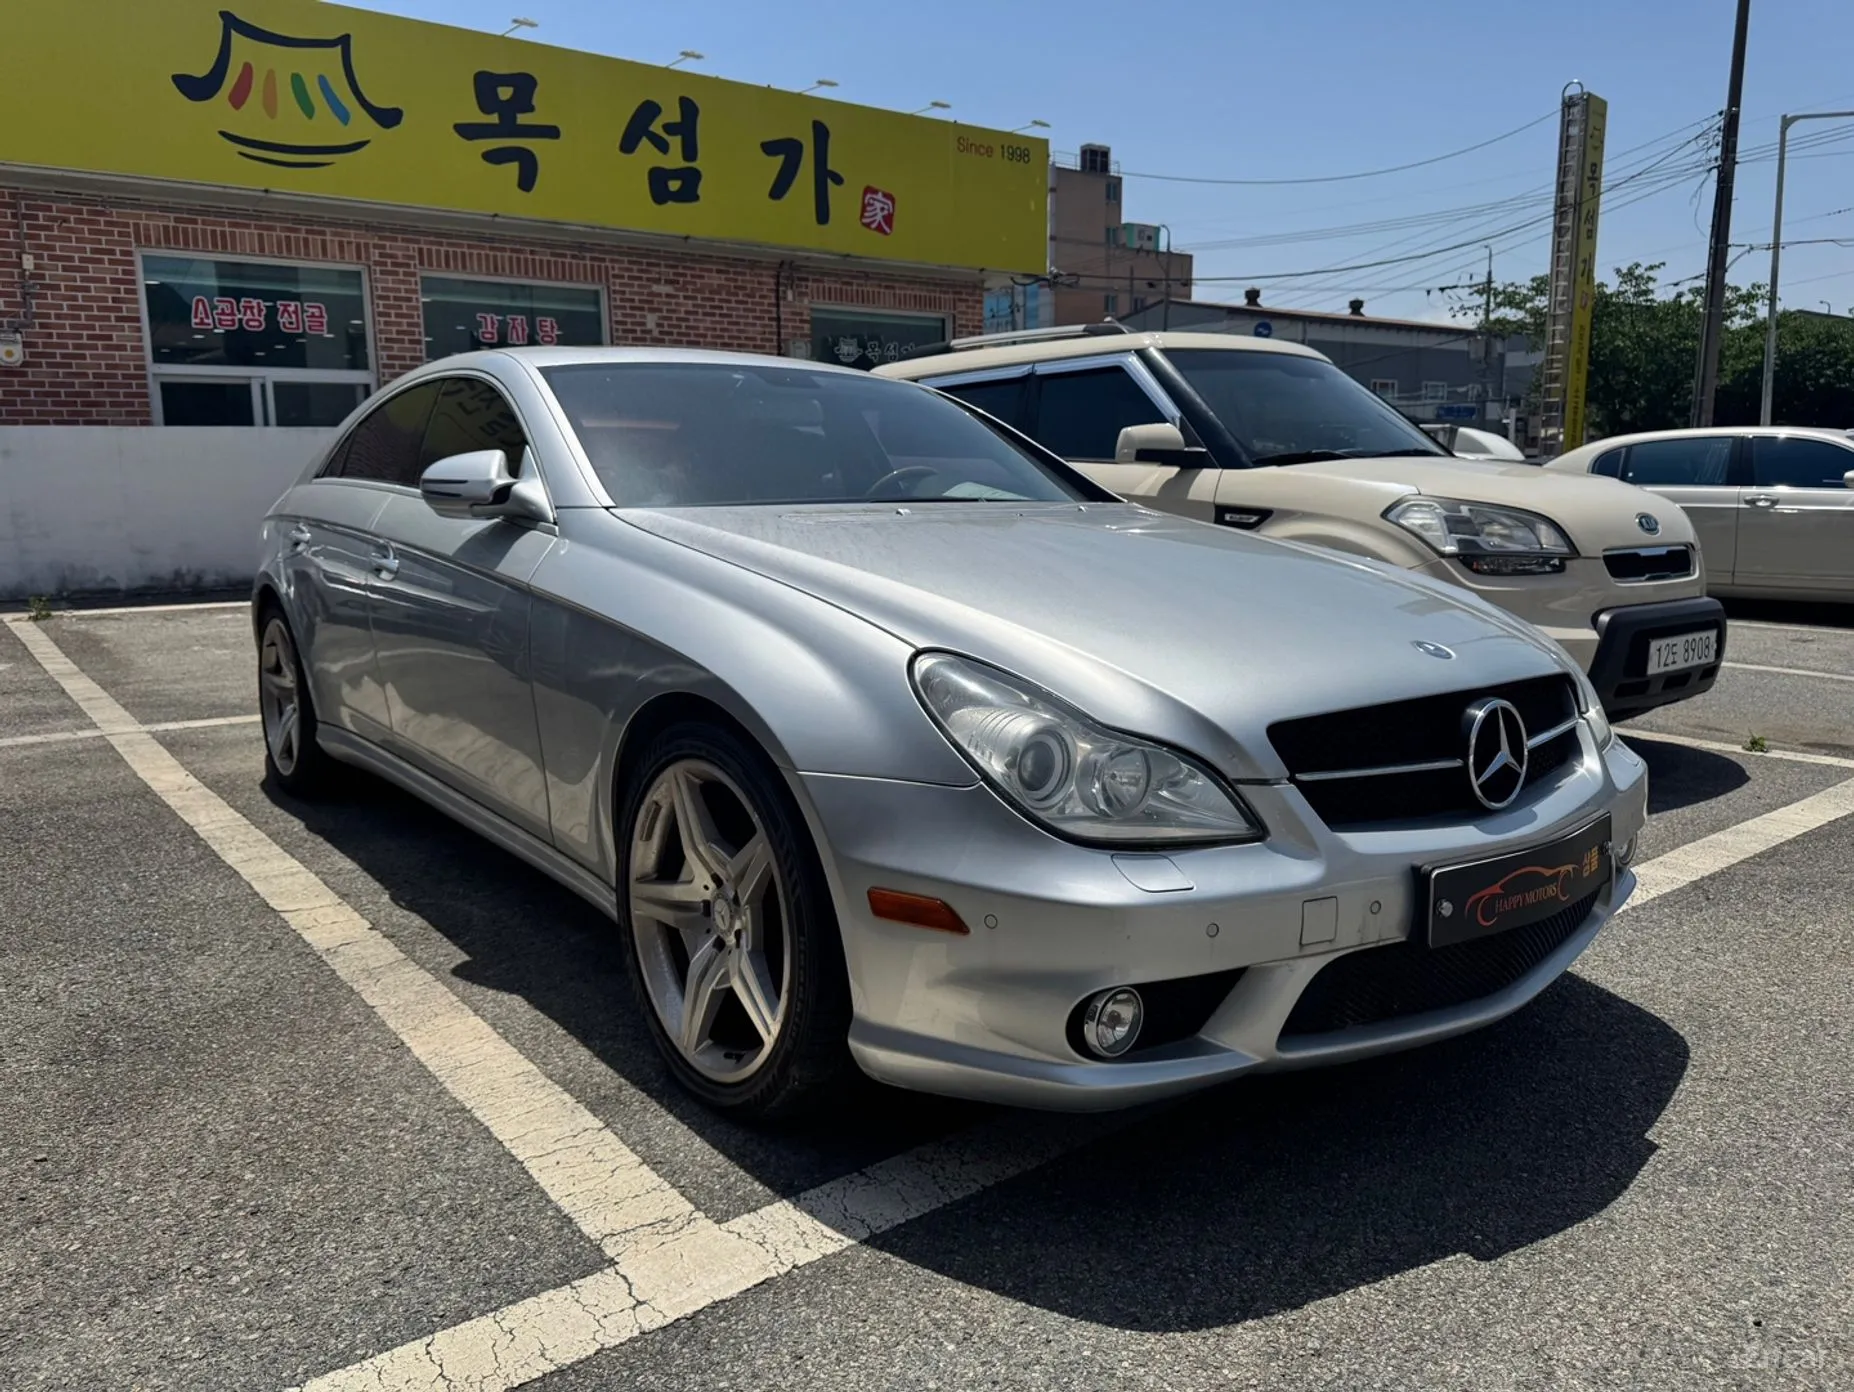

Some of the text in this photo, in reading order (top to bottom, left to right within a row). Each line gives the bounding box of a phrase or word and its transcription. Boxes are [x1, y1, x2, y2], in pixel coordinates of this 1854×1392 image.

[956, 135, 1031, 164] Since 1998
[862, 191, 894, 233] 家
[191, 296, 327, 334] 소곱창 전골
[1682, 635, 1711, 663] 8908
[1496, 883, 1557, 912] HAPPY MOTORS
